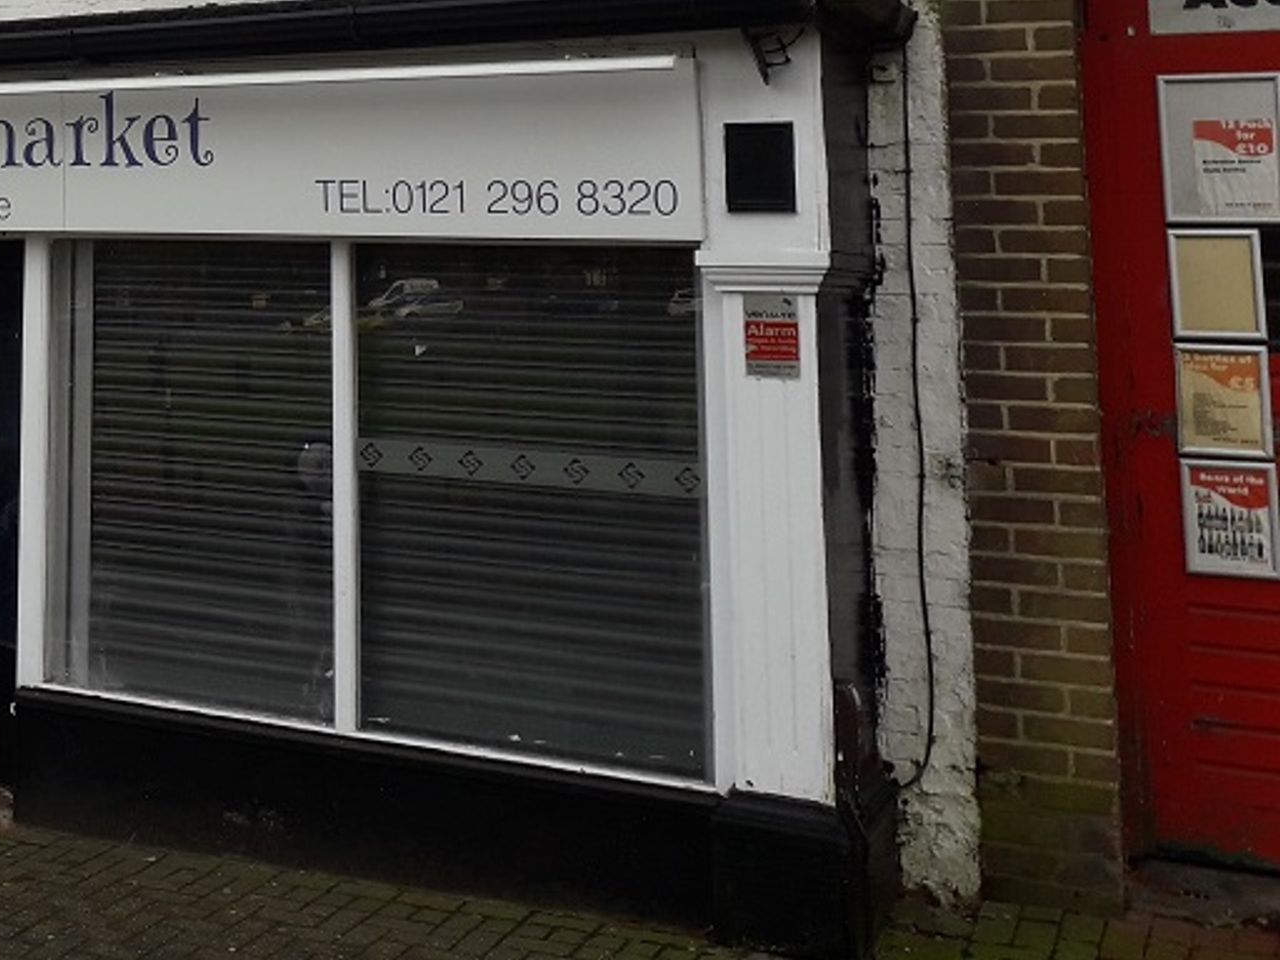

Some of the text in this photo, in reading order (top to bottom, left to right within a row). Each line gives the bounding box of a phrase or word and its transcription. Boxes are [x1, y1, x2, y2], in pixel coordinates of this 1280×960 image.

[1235, 142, 1269, 154] £10
[315, 179, 679, 216] TEL:0121 296 8320
[747, 323, 797, 337] Alarm
